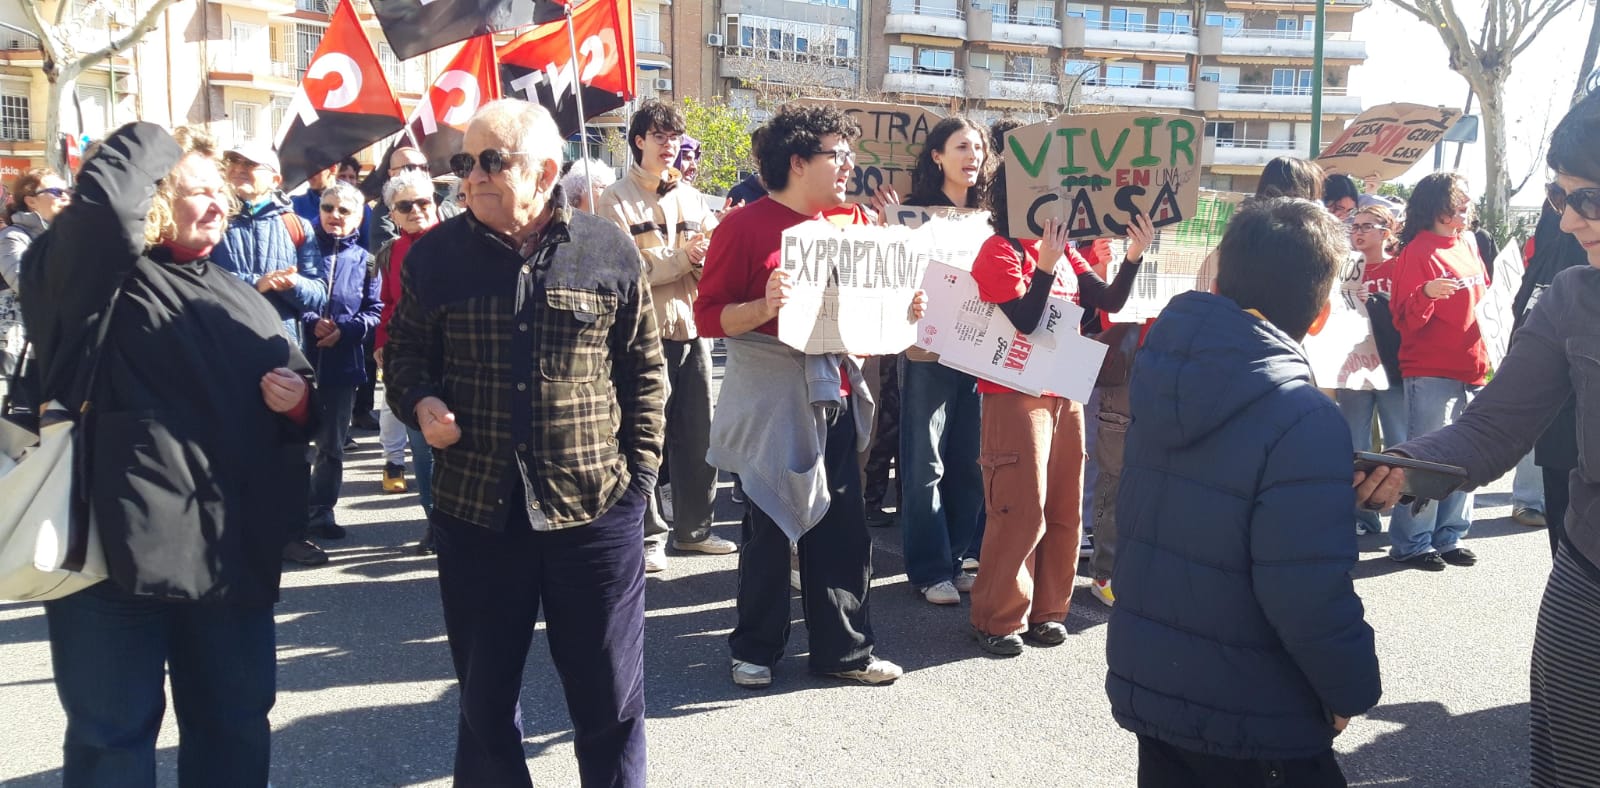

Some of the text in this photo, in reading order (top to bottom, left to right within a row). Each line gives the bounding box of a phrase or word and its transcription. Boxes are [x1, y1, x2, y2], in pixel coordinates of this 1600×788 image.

[1008, 117, 1196, 177] VIVIR
[1392, 147, 1423, 159] CASA
[1116, 169, 1150, 186] EN
[1026, 184, 1183, 239] CASA
[992, 336, 1008, 366] Fritas
